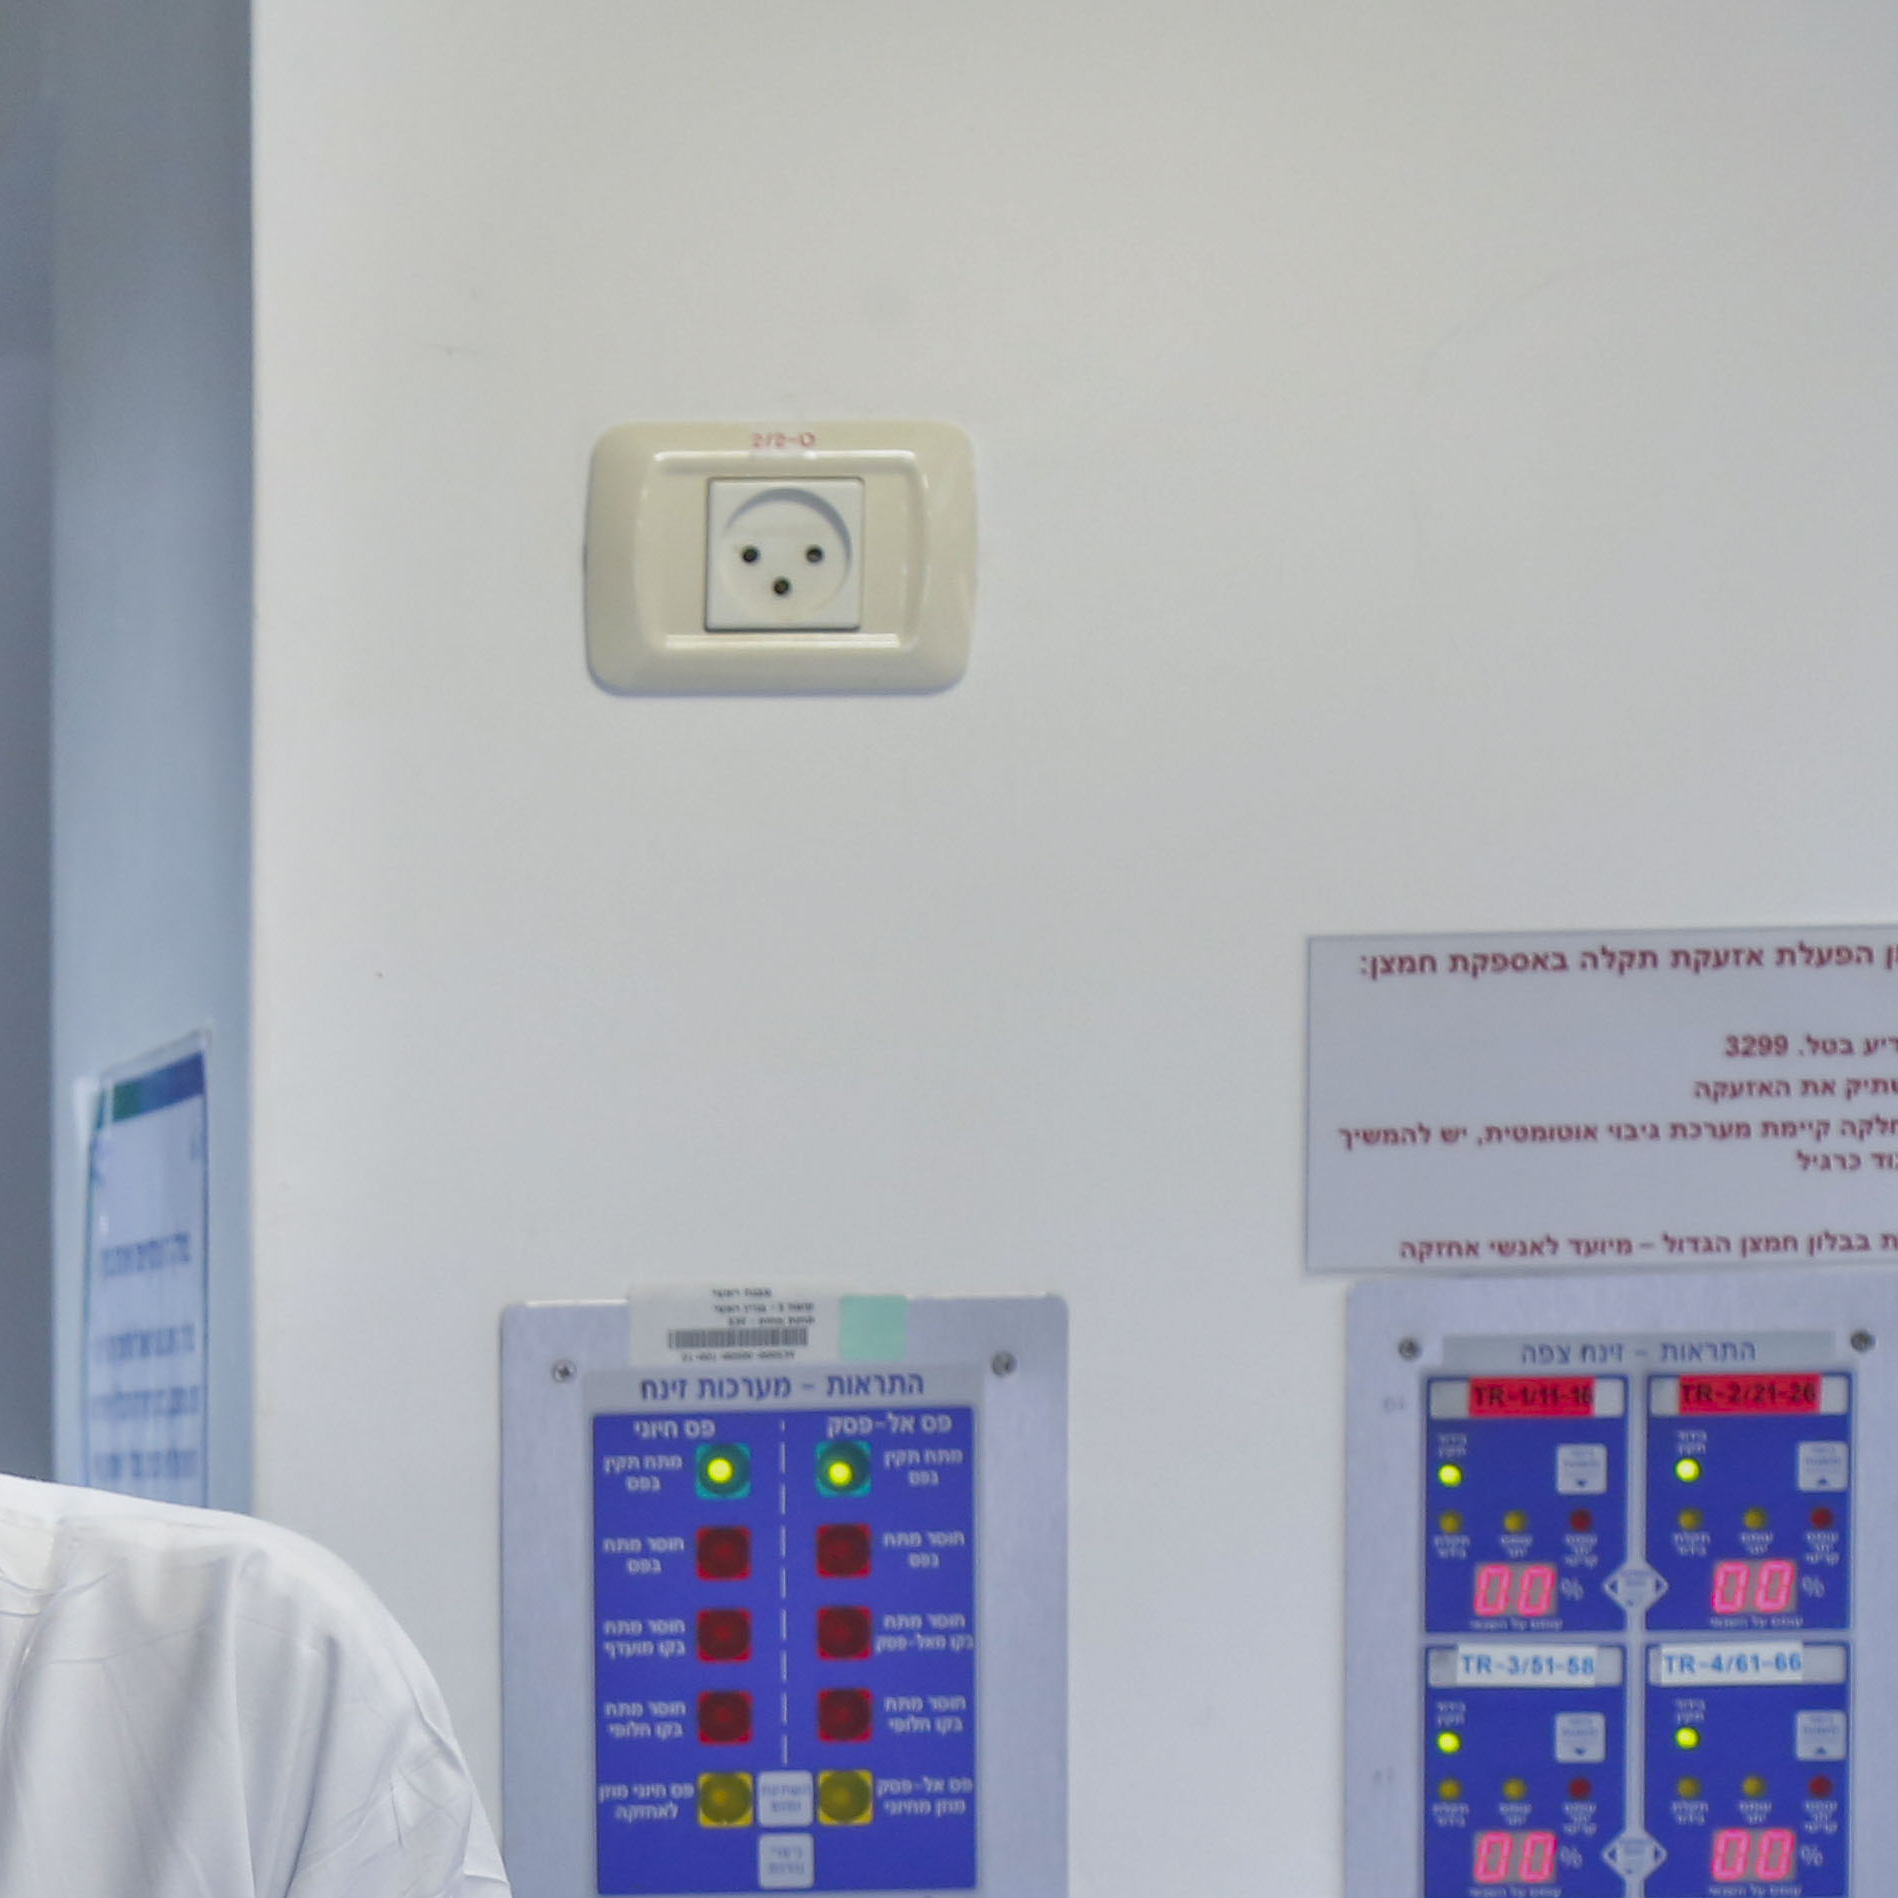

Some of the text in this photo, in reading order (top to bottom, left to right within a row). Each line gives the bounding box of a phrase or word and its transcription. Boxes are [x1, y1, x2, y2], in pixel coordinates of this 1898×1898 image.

[1449, 950, 1569, 979] באספקת
[1580, 945, 1659, 976] תקלה
[1669, 947, 1763, 974] אזעקת
[1775, 940, 1873, 967] הפעלת
[1361, 953, 1436, 980] חמצן:
[1724, 1034, 1789, 1058] 3299
[1694, 1080, 1791, 1103] האזעקה
[1800, 1079, 1836, 1097] את
[1339, 1122, 1431, 1151] להמשיך
[1440, 1126, 1467, 1144] יש
[1608, 1122, 1660, 1141] גיבוי
[1669, 1121, 1751, 1140] מערכת
[1760, 1119, 1831, 1142] קיימת
[1796, 1149, 1862, 1171] כרגיל
[1399, 1240, 1480, 1263] אחזקה
[1489, 1233, 1559, 1257] לאנשי
[1568, 1237, 1633, 1256] מיועד
[1662, 1231, 1732, 1254] הגדול
[1741, 1233, 1799, 1258] חמצן
[1808, 1229, 1871, 1257] בבלון
[1661, 1342, 1755, 1362] התראות
[697, 1376, 792, 1401] מערכות
[827, 1372, 924, 1398] התראות
[1473, 1563, 1557, 1617] 00
[1711, 1559, 1796, 1614] 00
[1473, 1830, 1557, 1883] 00
[1712, 1828, 1796, 1882] 00
